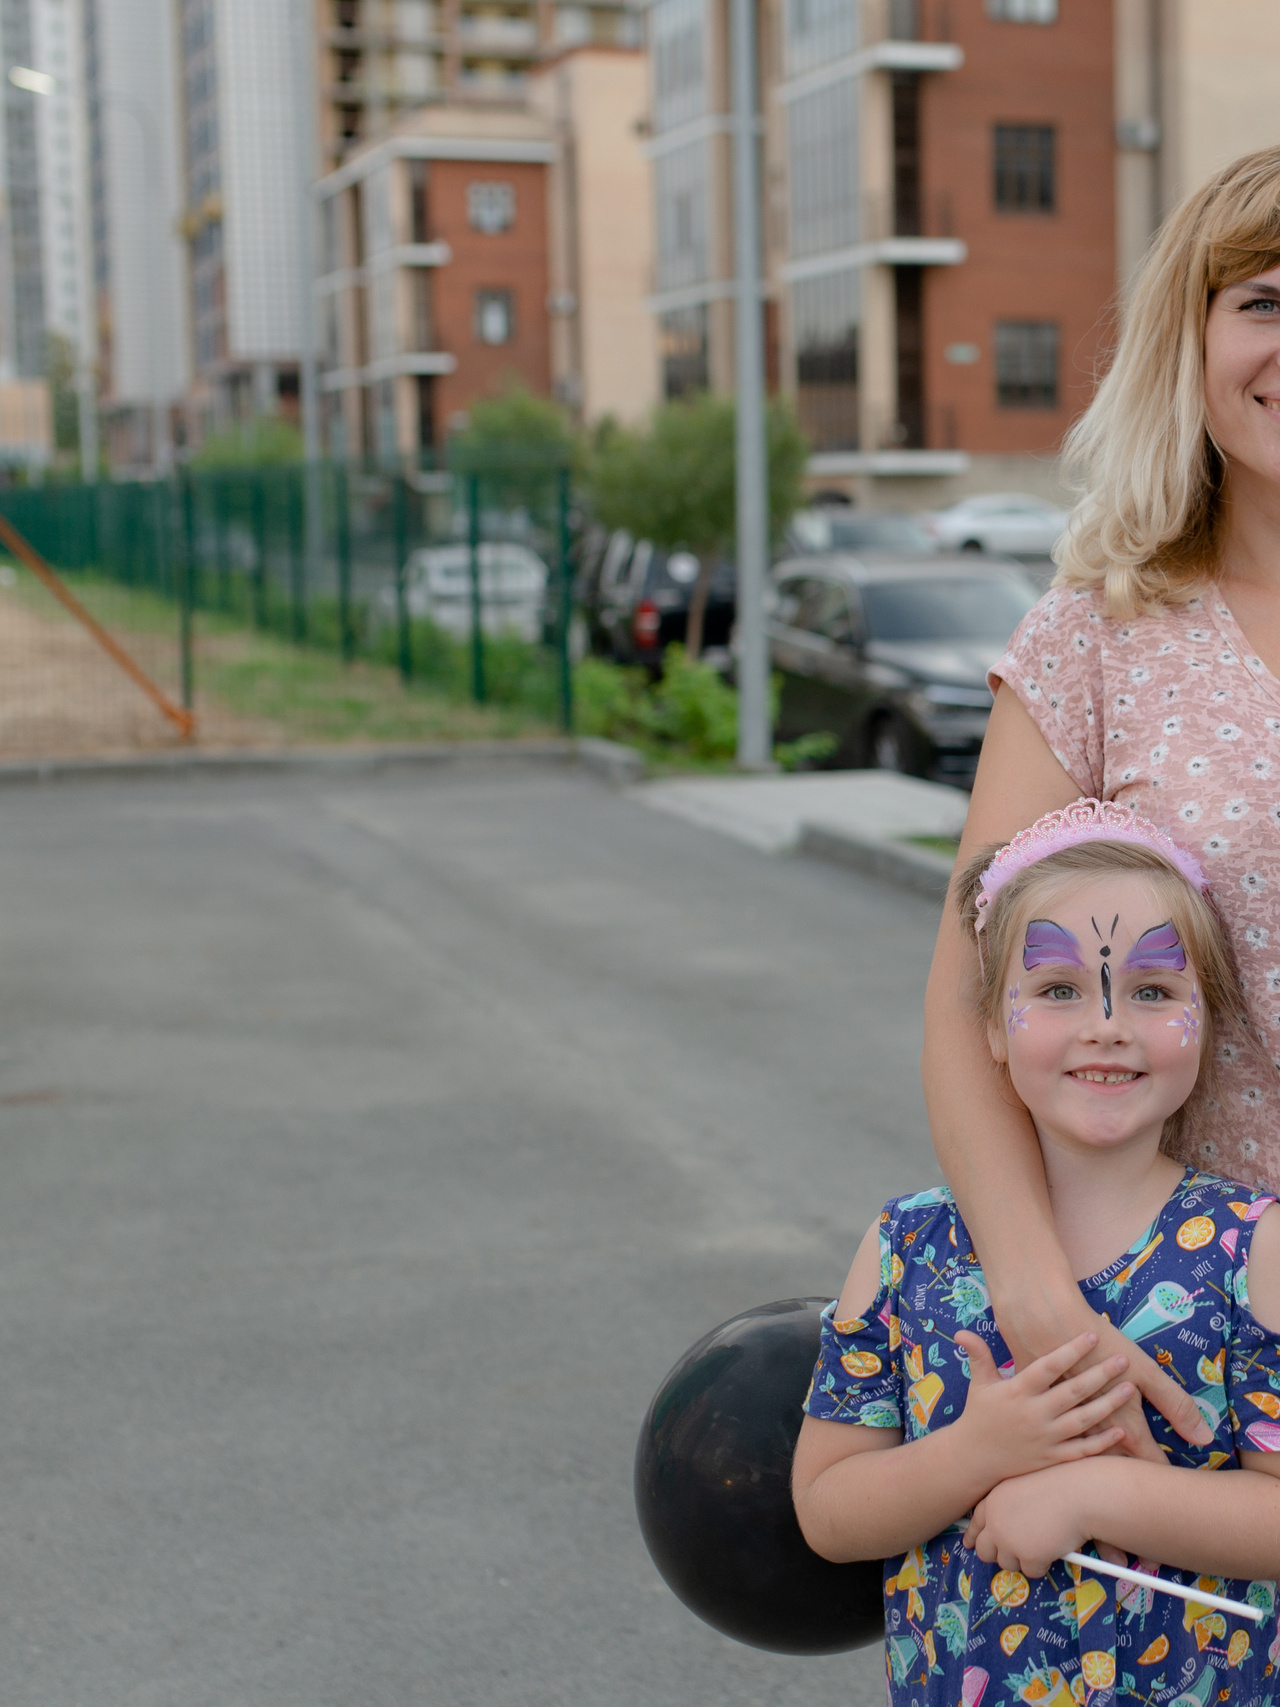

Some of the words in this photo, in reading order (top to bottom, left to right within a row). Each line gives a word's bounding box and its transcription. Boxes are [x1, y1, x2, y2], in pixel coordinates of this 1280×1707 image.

[1086, 1257, 1128, 1289] COCKTAIL
[1191, 1260, 1215, 1282] JUICE
[914, 1283, 928, 1311] DRINKS
[976, 1319, 999, 1333] COCK
[1177, 1328, 1210, 1351] DRINKS
[1036, 1627, 1069, 1650] DRINKS
